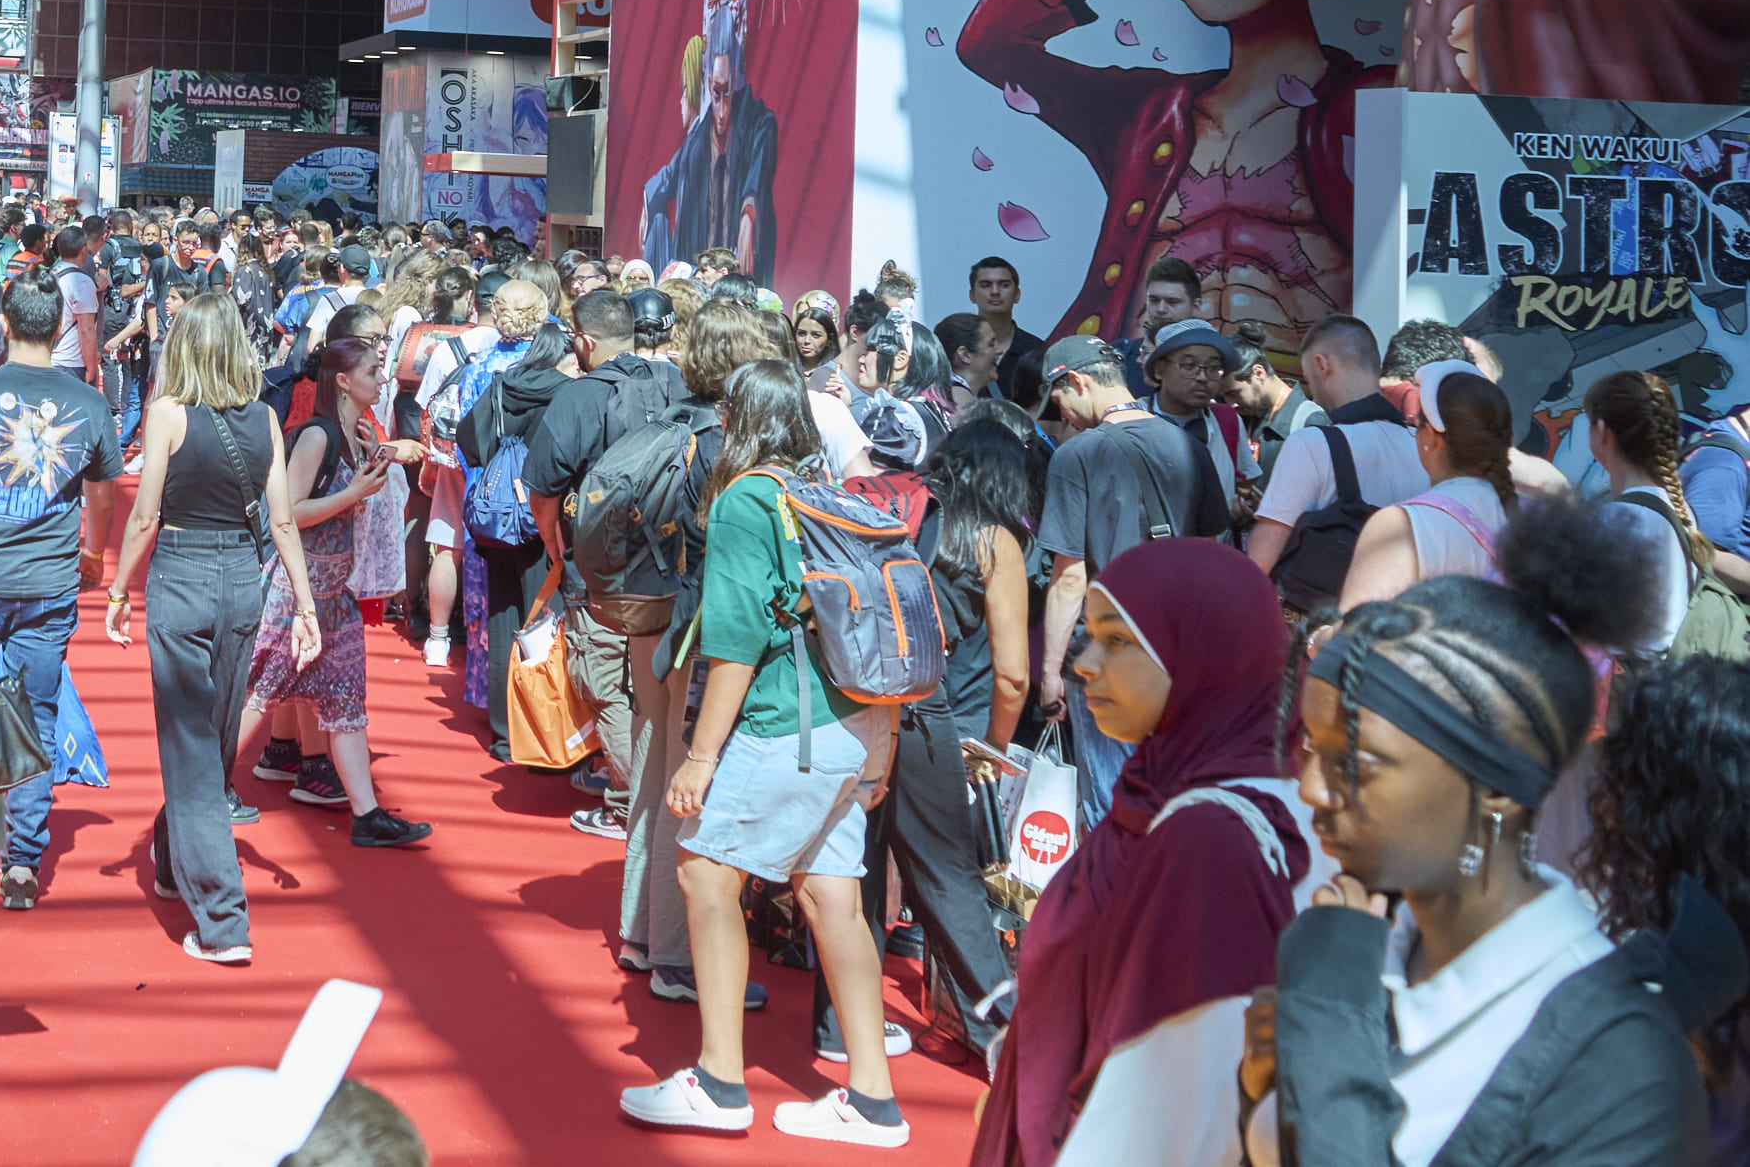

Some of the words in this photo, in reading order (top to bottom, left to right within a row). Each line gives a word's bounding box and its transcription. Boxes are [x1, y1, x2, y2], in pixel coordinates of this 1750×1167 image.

[186, 82, 300, 102] MANGAS.IO
[1513, 132, 1573, 159] KEN
[1581, 134, 1681, 163] WAKUI
[437, 190, 463, 205] NO
